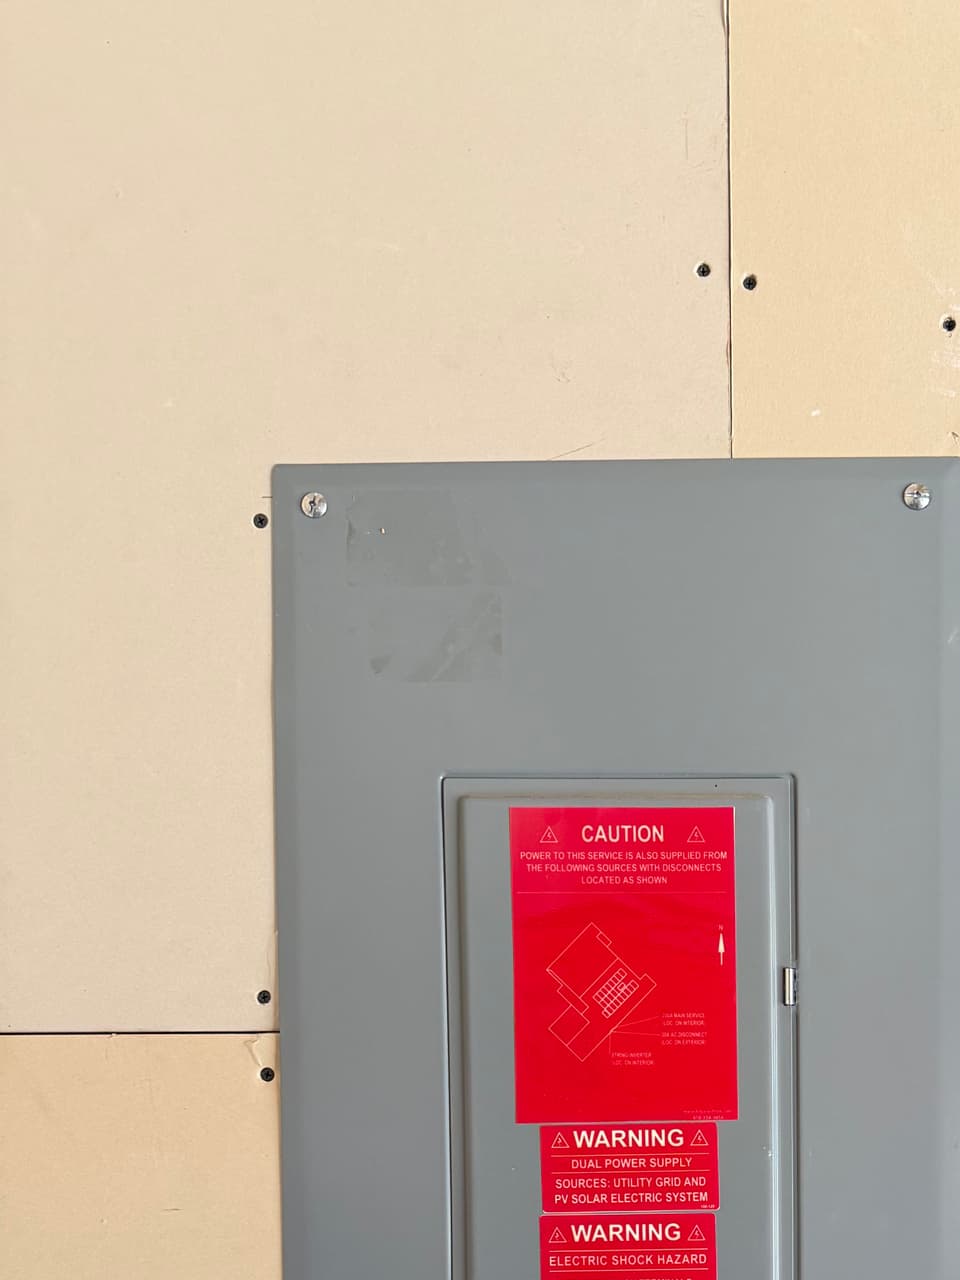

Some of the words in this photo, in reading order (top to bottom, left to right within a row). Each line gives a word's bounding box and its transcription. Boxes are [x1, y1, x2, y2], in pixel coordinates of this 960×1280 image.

[581, 824, 665, 843] CAUTION
[520, 851, 551, 860] POWER
[553, 851, 565, 860] TO
[567, 851, 586, 860] THIS
[587, 851, 624, 860] SERVICE
[625, 851, 634, 860] IS
[635, 851, 659, 860] ALSO
[660, 851, 701, 860] SUPPLIED
[703, 851, 728, 860] FROM
[526, 863, 543, 873] THE
[545, 863, 595, 873] FOLLOWING
[596, 863, 637, 873] SOURCES
[639, 863, 661, 873] WITH
[662, 863, 722, 873] DISCONNECTS
[581, 876, 621, 885] LOCATED
[623, 876, 634, 885] AS
[636, 876, 667, 885] SHOWN
[572, 1128, 684, 1148] WARNING
[571, 1158, 602, 1169] DUAL
[604, 1158, 647, 1169] POWER
[649, 1157, 692, 1168] SUPPLY
[555, 1178, 611, 1189] SOURCES:
[613, 1177, 651, 1188] UTILITY
[655, 1176, 681, 1187] GRID
[683, 1176, 706, 1187] AND
[554, 1194, 569, 1204] PV
[571, 1193, 608, 1204] SOLAR
[610, 1192, 663, 1203] ELECTRIC
[665, 1191, 708, 1202] SYSTEM
[570, 1223, 681, 1243] WARNING
[549, 1255, 608, 1267] ELECTRIC
[611, 1254, 654, 1266] SHOCK
[657, 1253, 708, 1265] HAZARD
